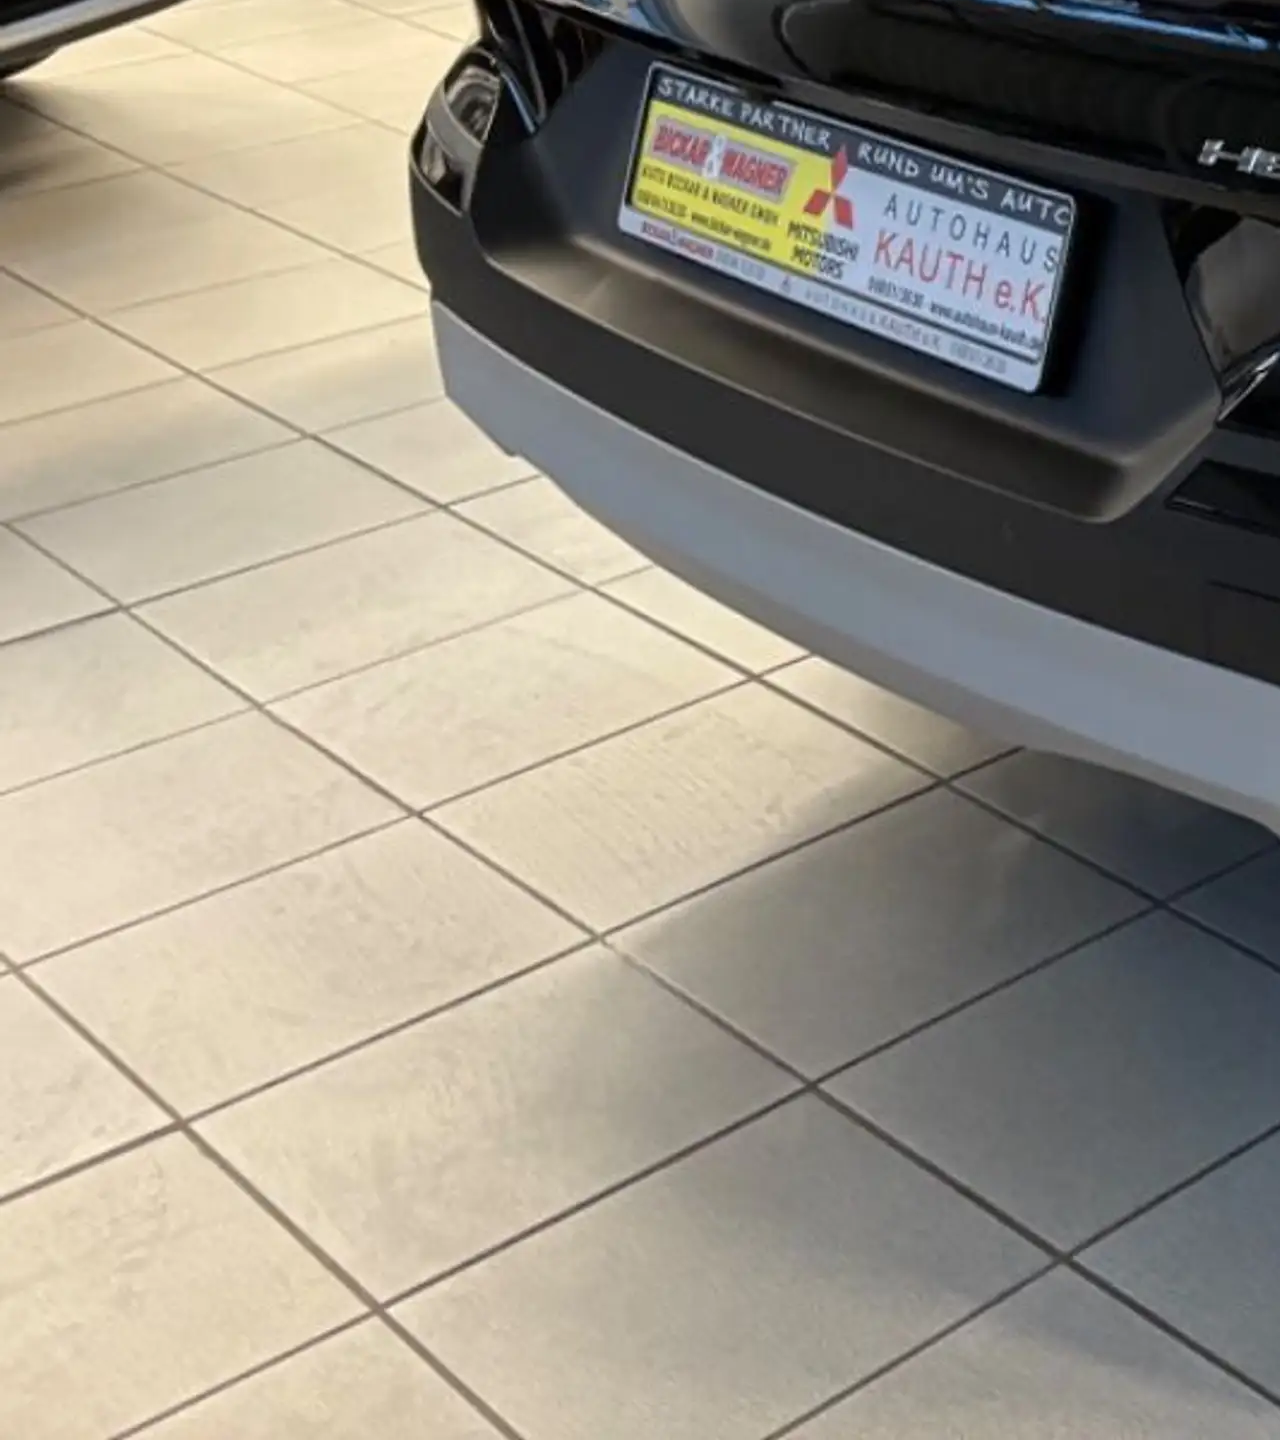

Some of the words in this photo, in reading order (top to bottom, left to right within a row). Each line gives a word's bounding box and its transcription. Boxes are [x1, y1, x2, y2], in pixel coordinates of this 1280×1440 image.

[658, 77, 735, 118] STARKE
[740, 102, 831, 150] PARTNER
[858, 142, 920, 178] RUND
[930, 165, 989, 201] UM'S
[787, 220, 860, 263] MITSUBISHI
[790, 245, 845, 281] MOTORS
[873, 228, 989, 303] KAUTH
[884, 192, 1061, 273] AUTOHAUS
